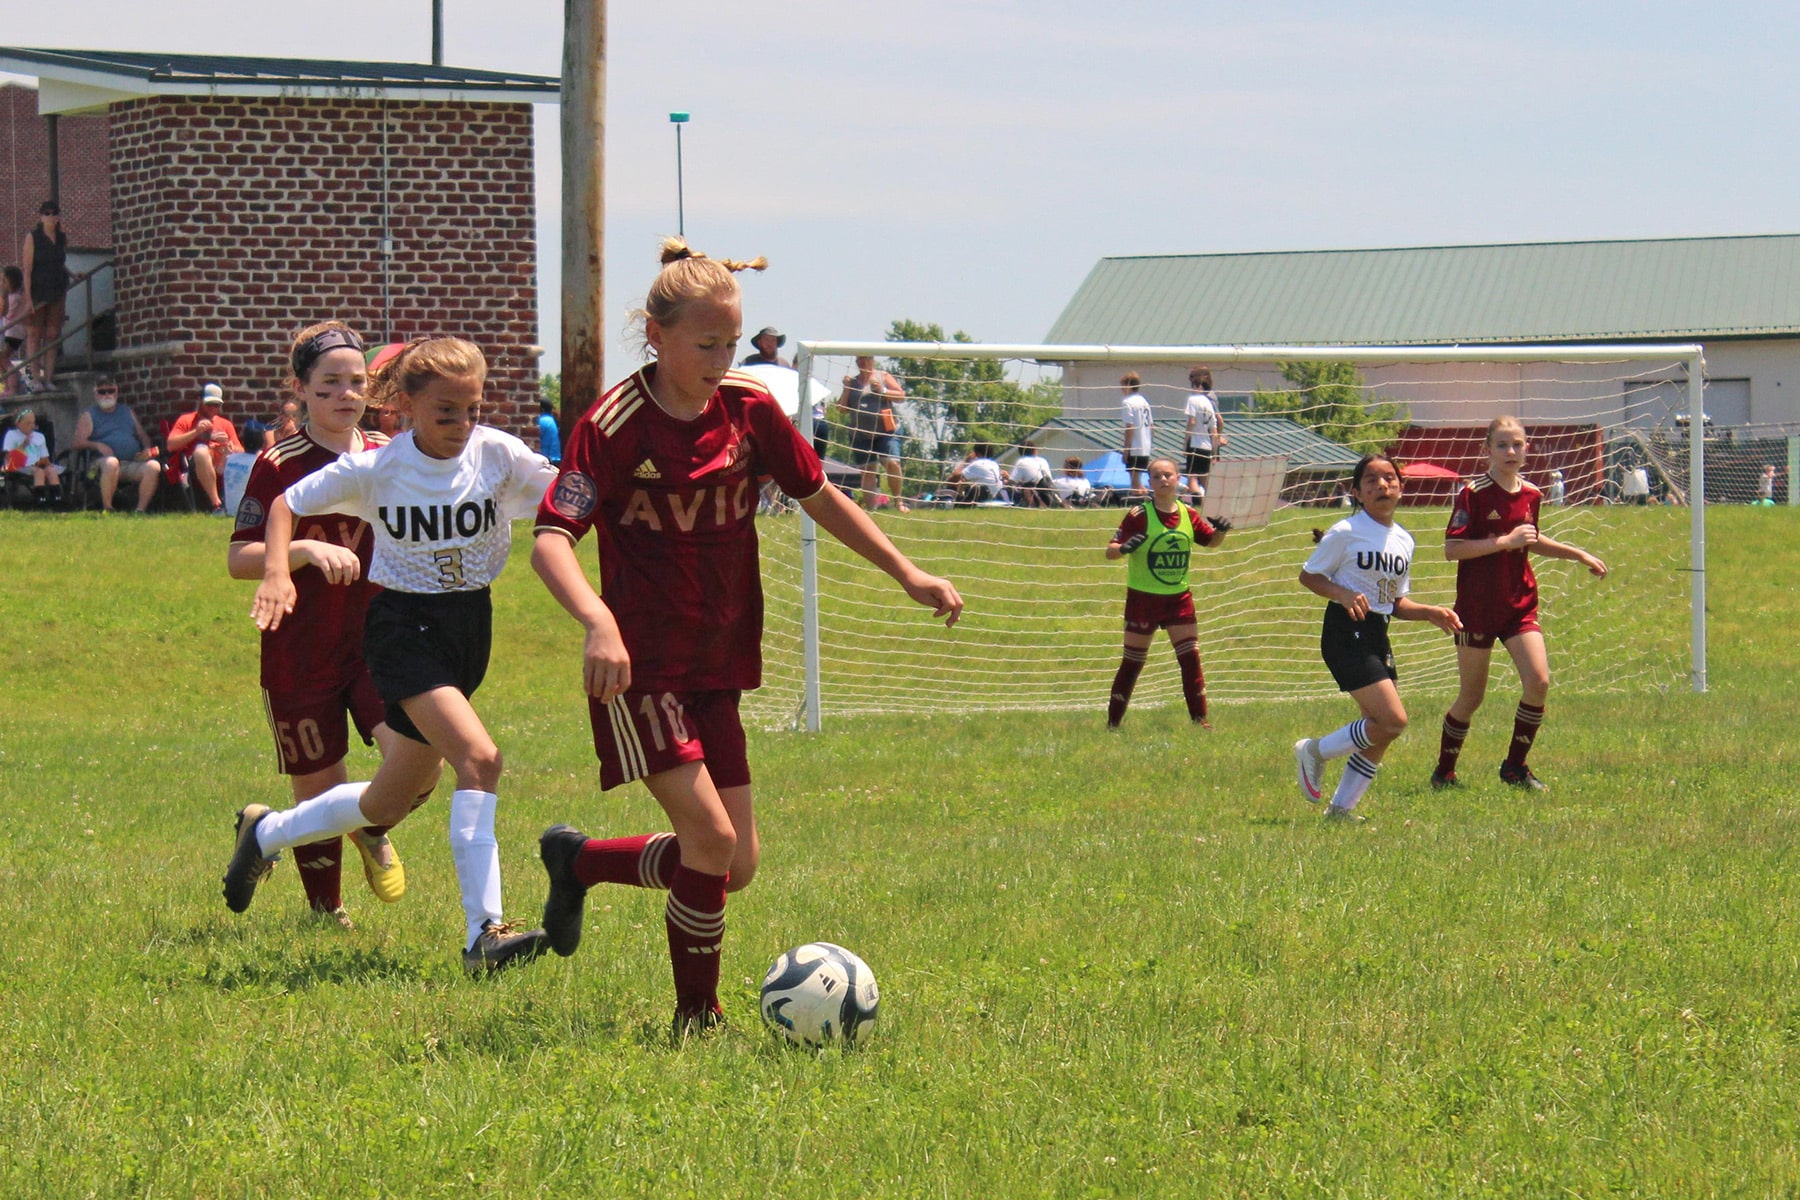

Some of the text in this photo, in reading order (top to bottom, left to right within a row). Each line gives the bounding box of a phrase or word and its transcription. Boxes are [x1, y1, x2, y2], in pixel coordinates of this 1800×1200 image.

[237, 511, 258, 524] VID
[379, 498, 498, 542] UNION
[434, 548, 467, 589] 3
[277, 718, 326, 765] 50
[639, 691, 689, 752] 10
